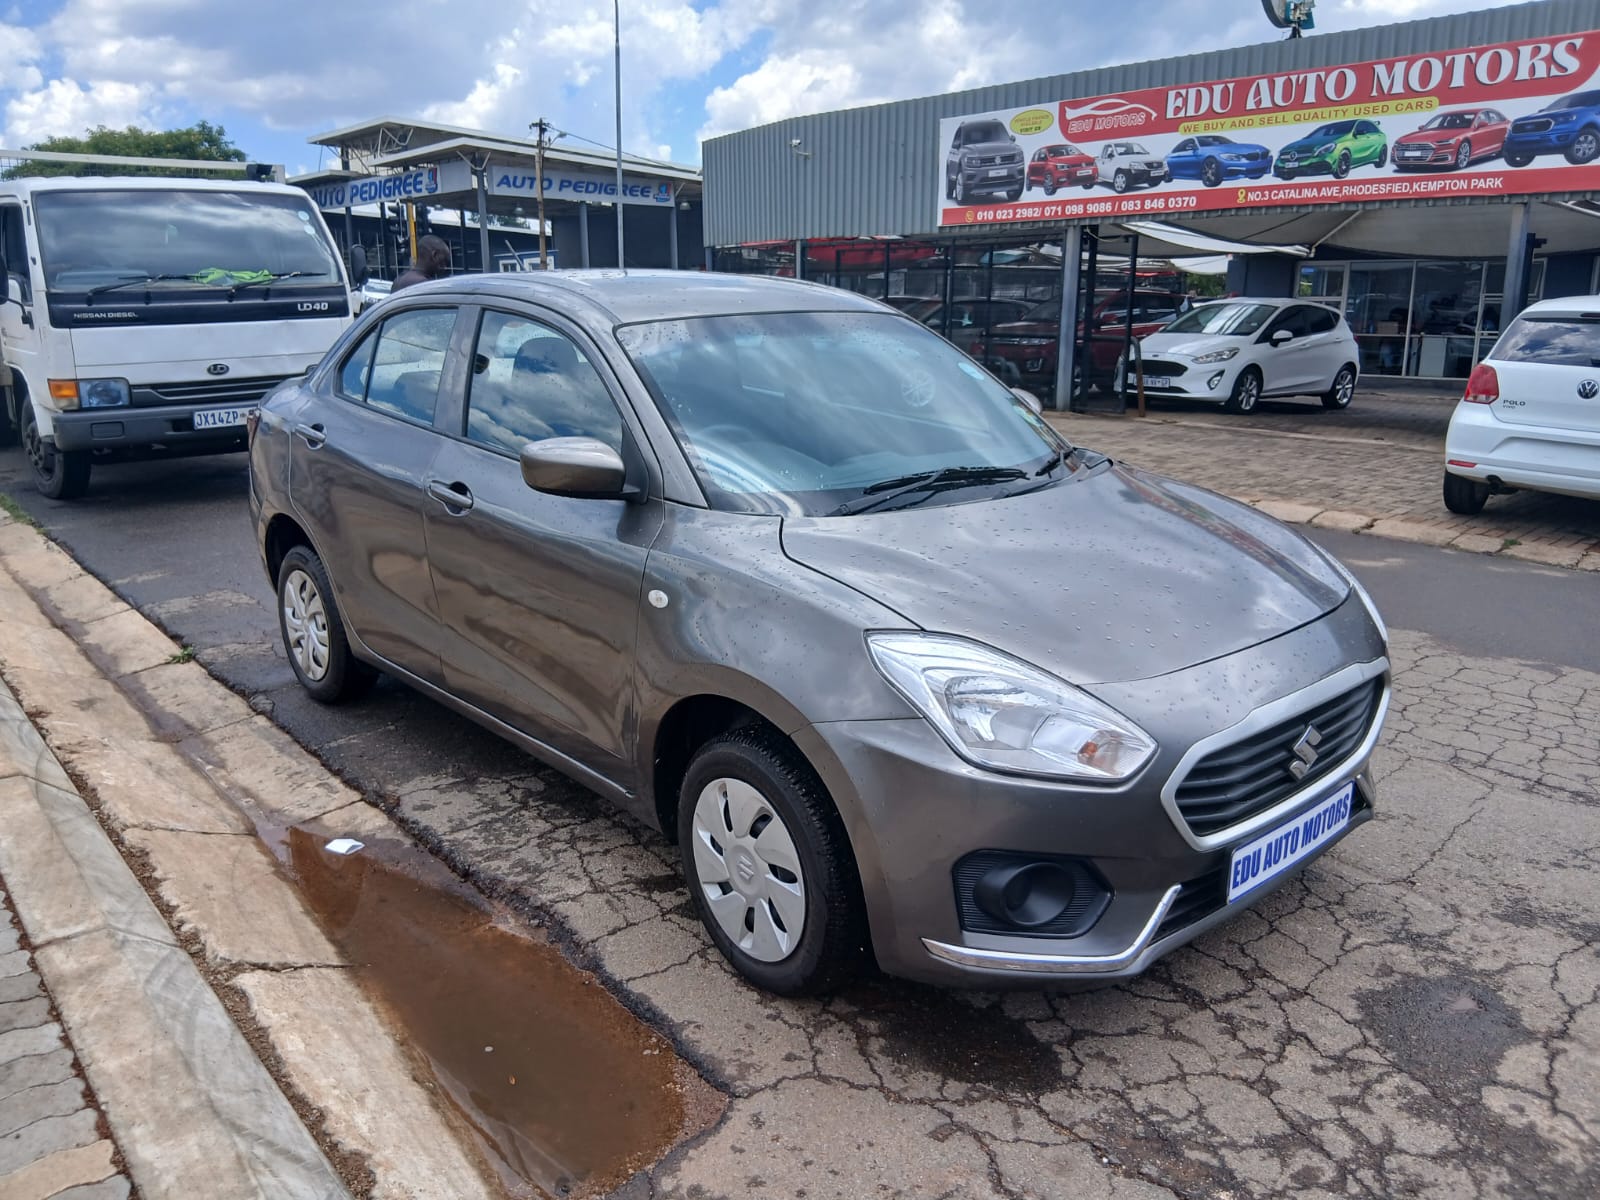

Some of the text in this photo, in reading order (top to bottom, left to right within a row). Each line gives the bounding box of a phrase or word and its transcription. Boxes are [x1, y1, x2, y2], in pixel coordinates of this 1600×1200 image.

[1165, 37, 1584, 119] EDU AUTO MOTORS
[1067, 112, 1146, 134] EDU MOTORS
[1183, 99, 1433, 133] WE BUY AND SELL QUALITY USED CARS
[351, 172, 424, 203] PEDIGREE
[497, 174, 652, 198] AUTO PEDIGREE
[1247, 191, 1269, 201] NO.3
[1271, 188, 1318, 200] CATALINA
[1470, 177, 1504, 190] PARK
[976, 211, 994, 220] 010
[996, 210, 1013, 219] 023
[1044, 206, 1062, 216] 071
[1065, 204, 1084, 214] 098
[1086, 202, 1112, 213] 9086
[1121, 200, 1141, 211] 083
[1144, 198, 1165, 209] 846
[1168, 196, 1197, 208] 0370
[1503, 399, 1526, 407] POLO
[196, 410, 239, 426] JX14ZP
[1231, 793, 1350, 890] EDU AUTO MOTORS
